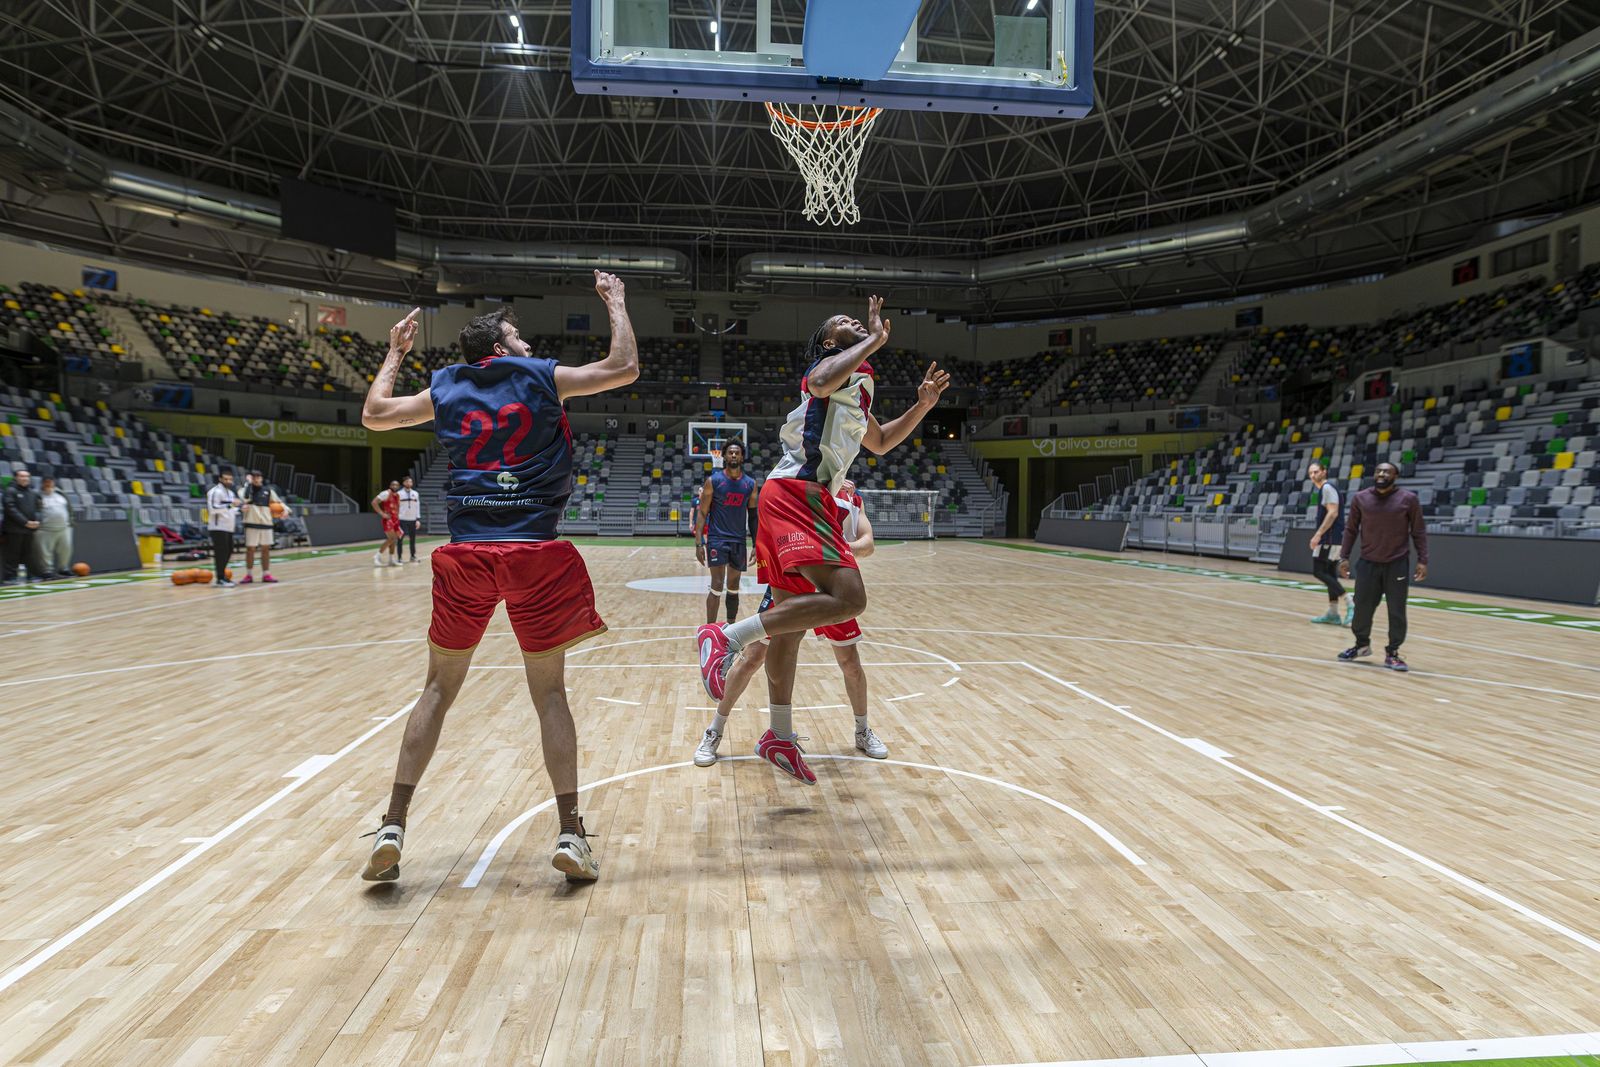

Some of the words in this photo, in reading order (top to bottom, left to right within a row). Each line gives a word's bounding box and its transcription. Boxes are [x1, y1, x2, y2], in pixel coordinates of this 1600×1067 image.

[606, 418, 618, 428] 30
[647, 419, 659, 429] 30
[278, 421, 316, 436] olivo
[320, 425, 367, 440] arena
[460, 402, 533, 470] 22
[1058, 437, 1090, 450] olivo
[1094, 437, 1137, 448] arena
